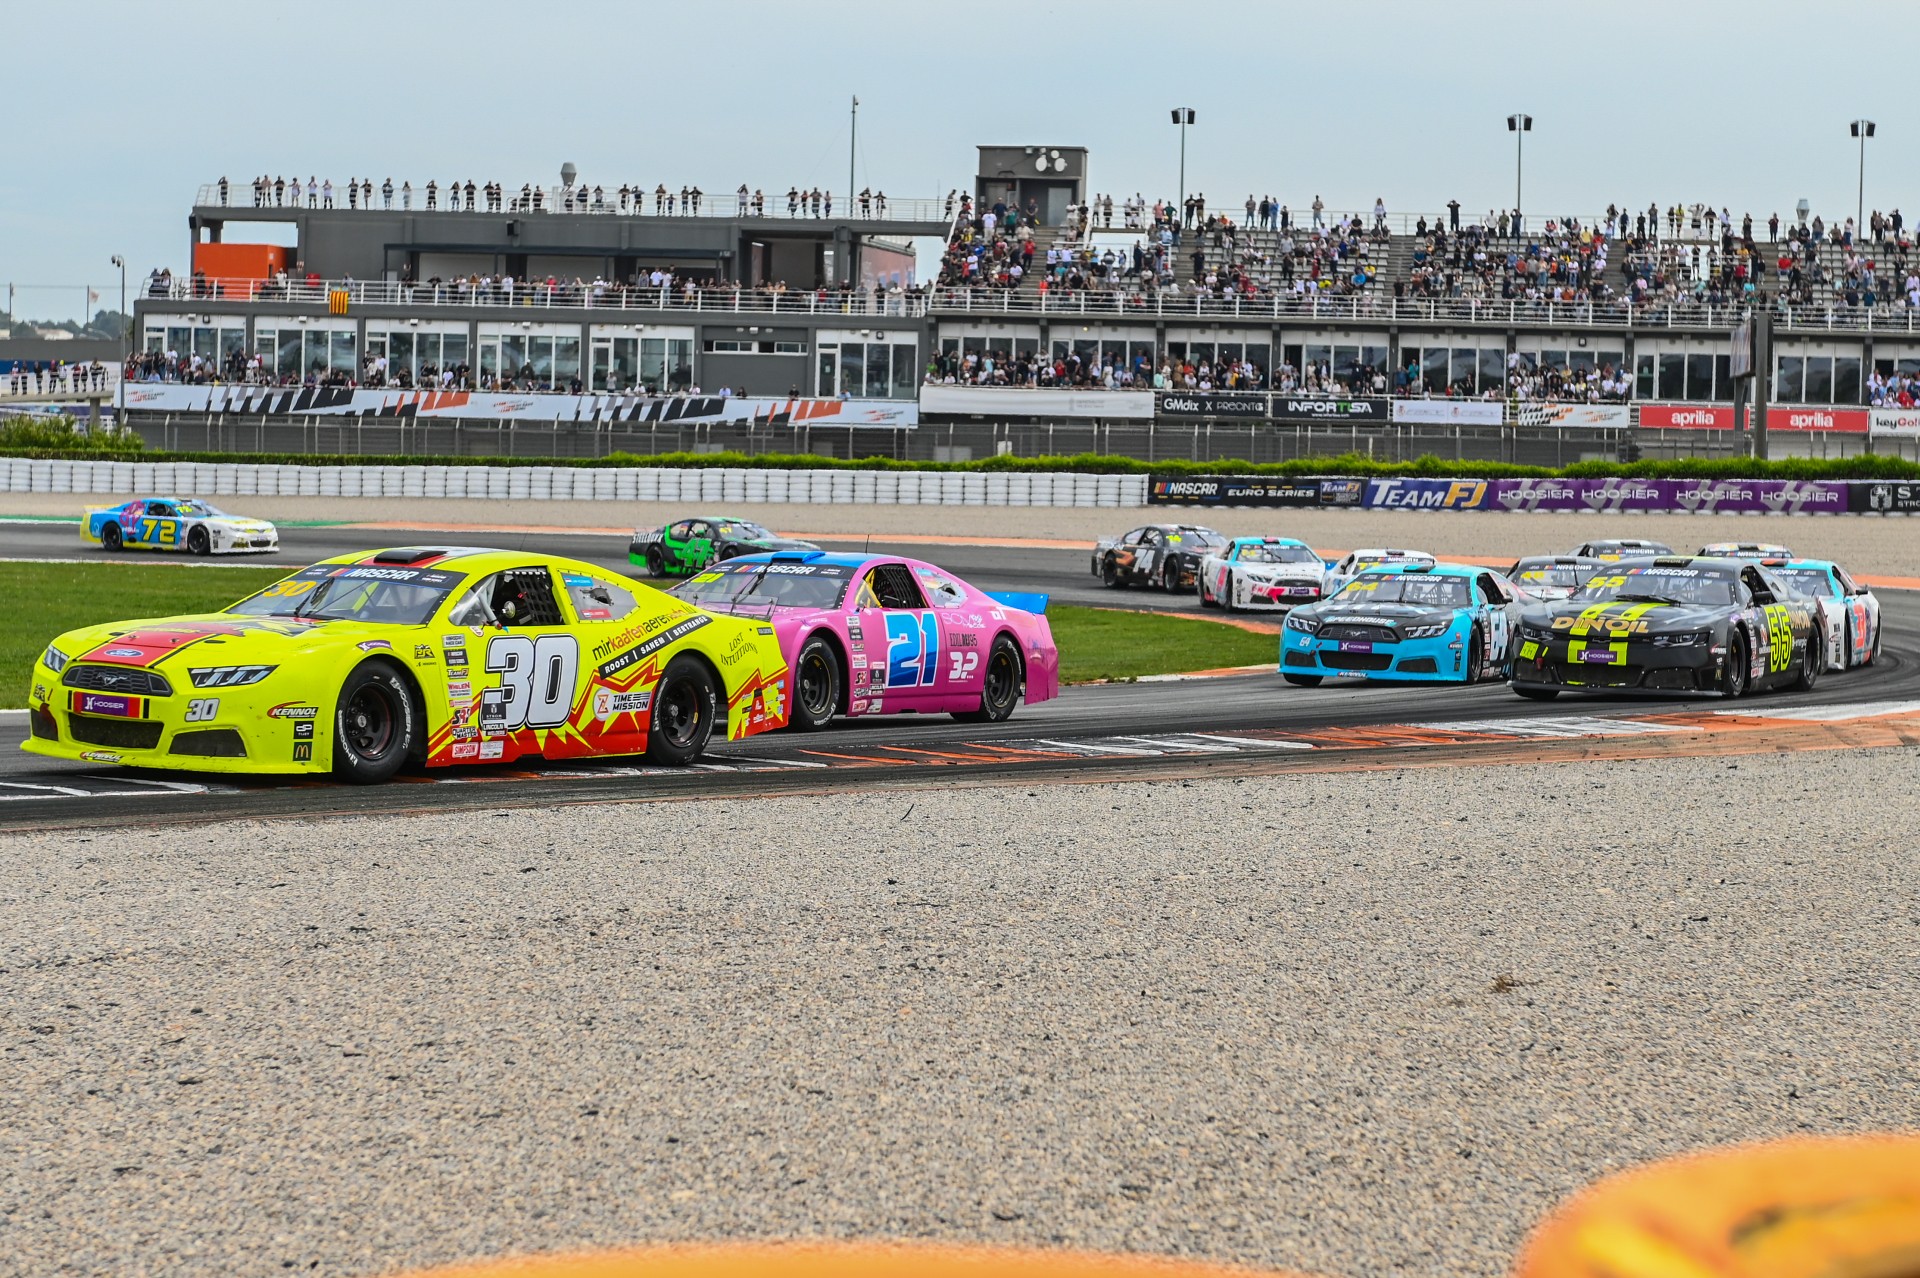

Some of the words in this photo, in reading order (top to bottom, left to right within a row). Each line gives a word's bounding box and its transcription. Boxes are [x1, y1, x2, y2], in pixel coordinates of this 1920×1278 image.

[1164, 398, 1199, 411] GMdix
[1205, 401, 1212, 411] X
[1288, 402, 1372, 413] INFORTISA
[1671, 411, 1714, 426] aprilia
[1790, 412, 1833, 428] aprilia
[1169, 482, 1218, 495] NASCAR
[1227, 489, 1265, 497] EURO
[1267, 489, 1315, 498] SERIES
[1498, 489, 1574, 500] HOOSIER
[1581, 489, 1659, 500] HOOSIER
[1676, 490, 1753, 501] HOOSIER
[1760, 491, 1839, 503] HOOSIER
[142, 519, 176, 543] 72
[681, 537, 713, 568] 47
[1132, 548, 1156, 573] 74
[346, 568, 420, 580] NASCAR
[751, 565, 817, 575] NASCAR
[1645, 568, 1699, 577] NASCAR
[1586, 575, 1628, 588] 55
[263, 580, 318, 597] 30
[672, 615, 709, 637] BERTRANGE
[1551, 616, 1650, 633] DINOIL
[728, 632, 744, 652] LOST
[1298, 636, 1312, 647] 64
[1763, 604, 1792, 673] 55
[640, 637, 666, 655] SANEM
[883, 611, 939, 689] 21
[720, 642, 758, 667] INTUITIONS
[604, 655, 630, 674] ROOST
[480, 634, 580, 733] 30
[94, 700, 125, 710] HOOSIER
[613, 694, 633, 703] TIME
[185, 698, 220, 723] 30
[271, 706, 318, 716] KENNOL
[612, 701, 649, 711] MISSION
[455, 745, 475, 754] SIMPSON
